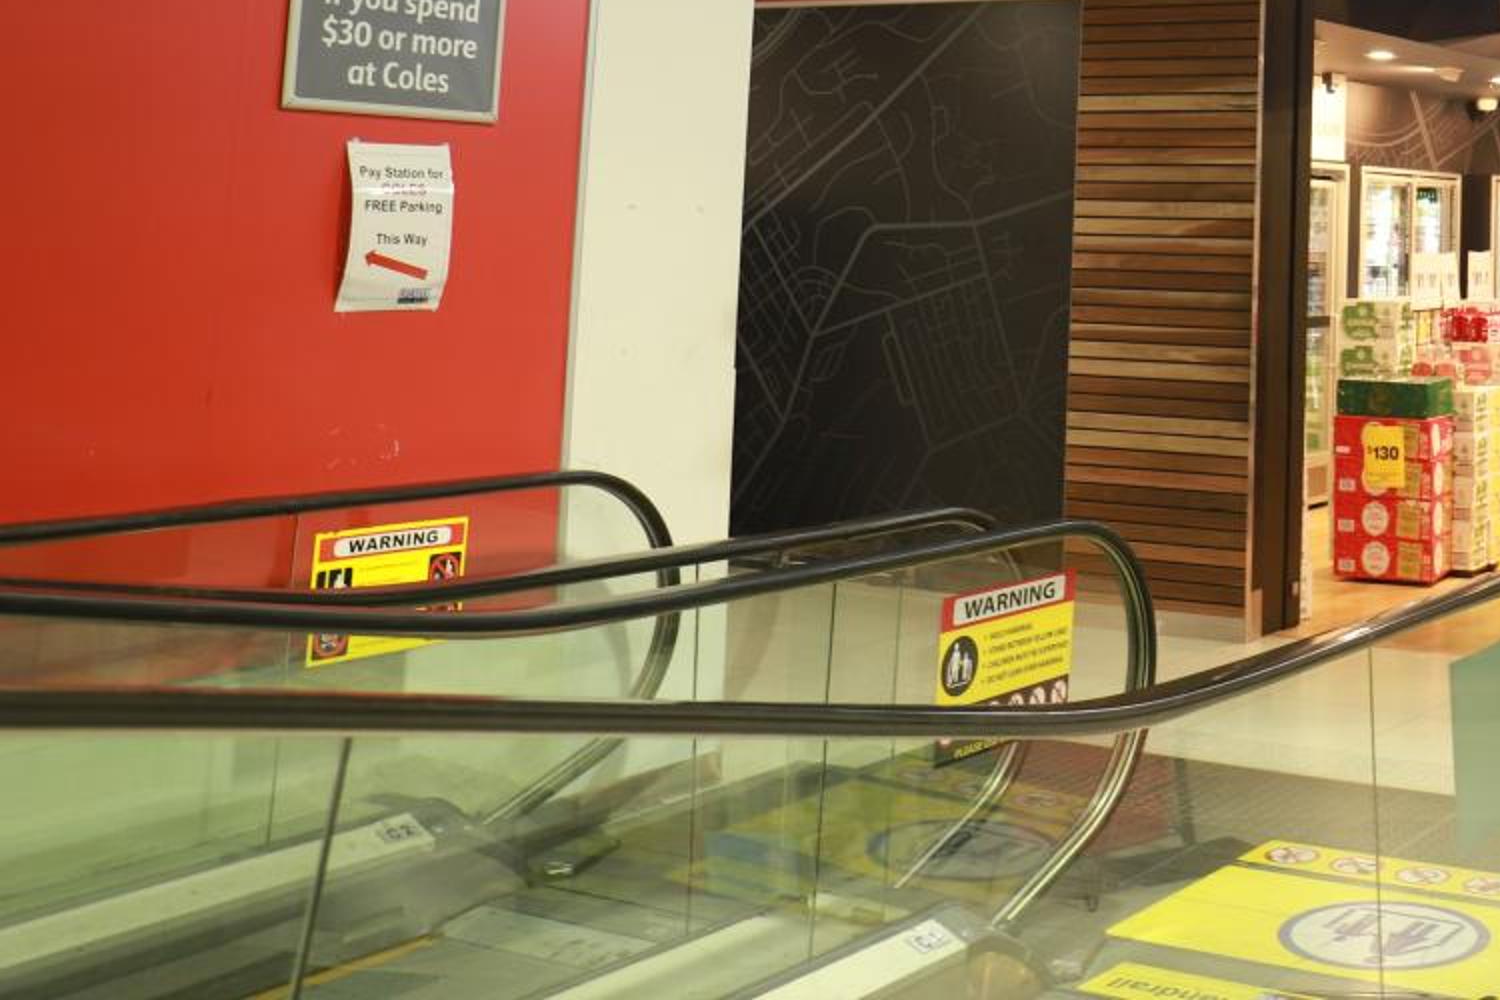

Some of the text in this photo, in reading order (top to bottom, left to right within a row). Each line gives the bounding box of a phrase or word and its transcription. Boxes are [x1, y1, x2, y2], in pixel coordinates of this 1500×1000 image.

[321, 14, 478, 60] $30 or more
[347, 60, 449, 93] at Coles
[359, 165, 444, 180] Pay Station for
[365, 199, 443, 215] FREE Parking
[376, 233, 428, 247] This Way
[348, 529, 440, 553] WARNING
[964, 581, 1056, 619] WARNING
